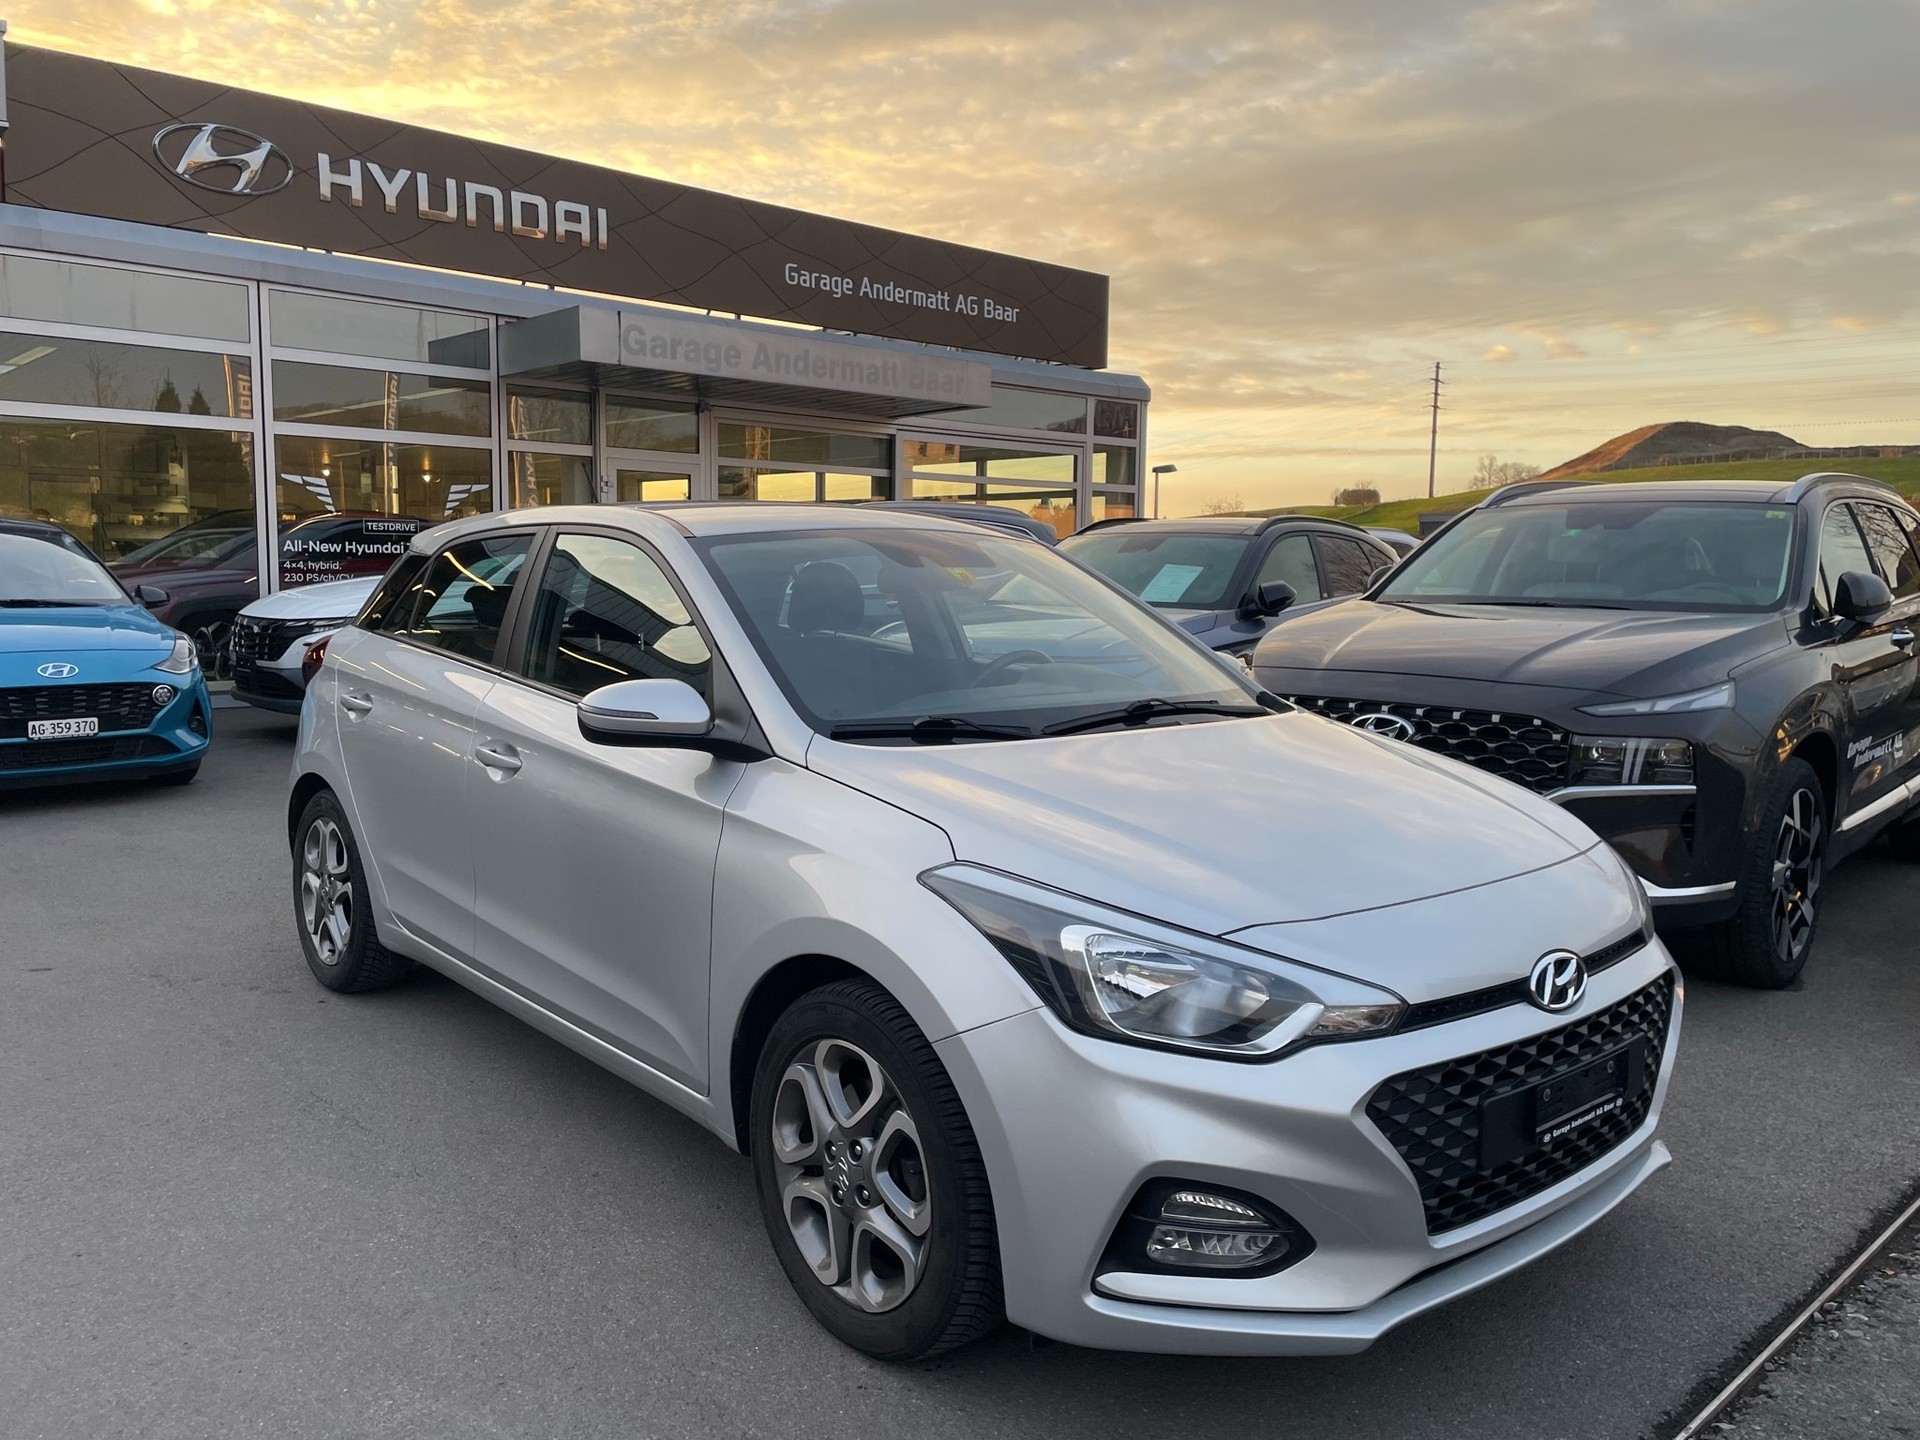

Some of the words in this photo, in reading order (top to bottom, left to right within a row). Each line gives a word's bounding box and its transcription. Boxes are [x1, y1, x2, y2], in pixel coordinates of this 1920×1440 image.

[317, 152, 608, 250] HYUNDAI
[785, 263, 854, 298] Garage
[859, 276, 950, 311] Andermatt
[955, 294, 979, 316] AG
[984, 299, 1020, 323] Baar
[622, 324, 742, 373] Garage
[751, 342, 899, 389] Andermatt
[908, 359, 964, 396] Baar
[367, 522, 416, 532] TESTDRIVE
[283, 540, 342, 552] All-New
[345, 542, 404, 556] Hyundai
[308, 560, 342, 571] hybrid.
[284, 573, 304, 582] 230
[50, 722, 71, 734] 359
[74, 720, 96, 733] 370
